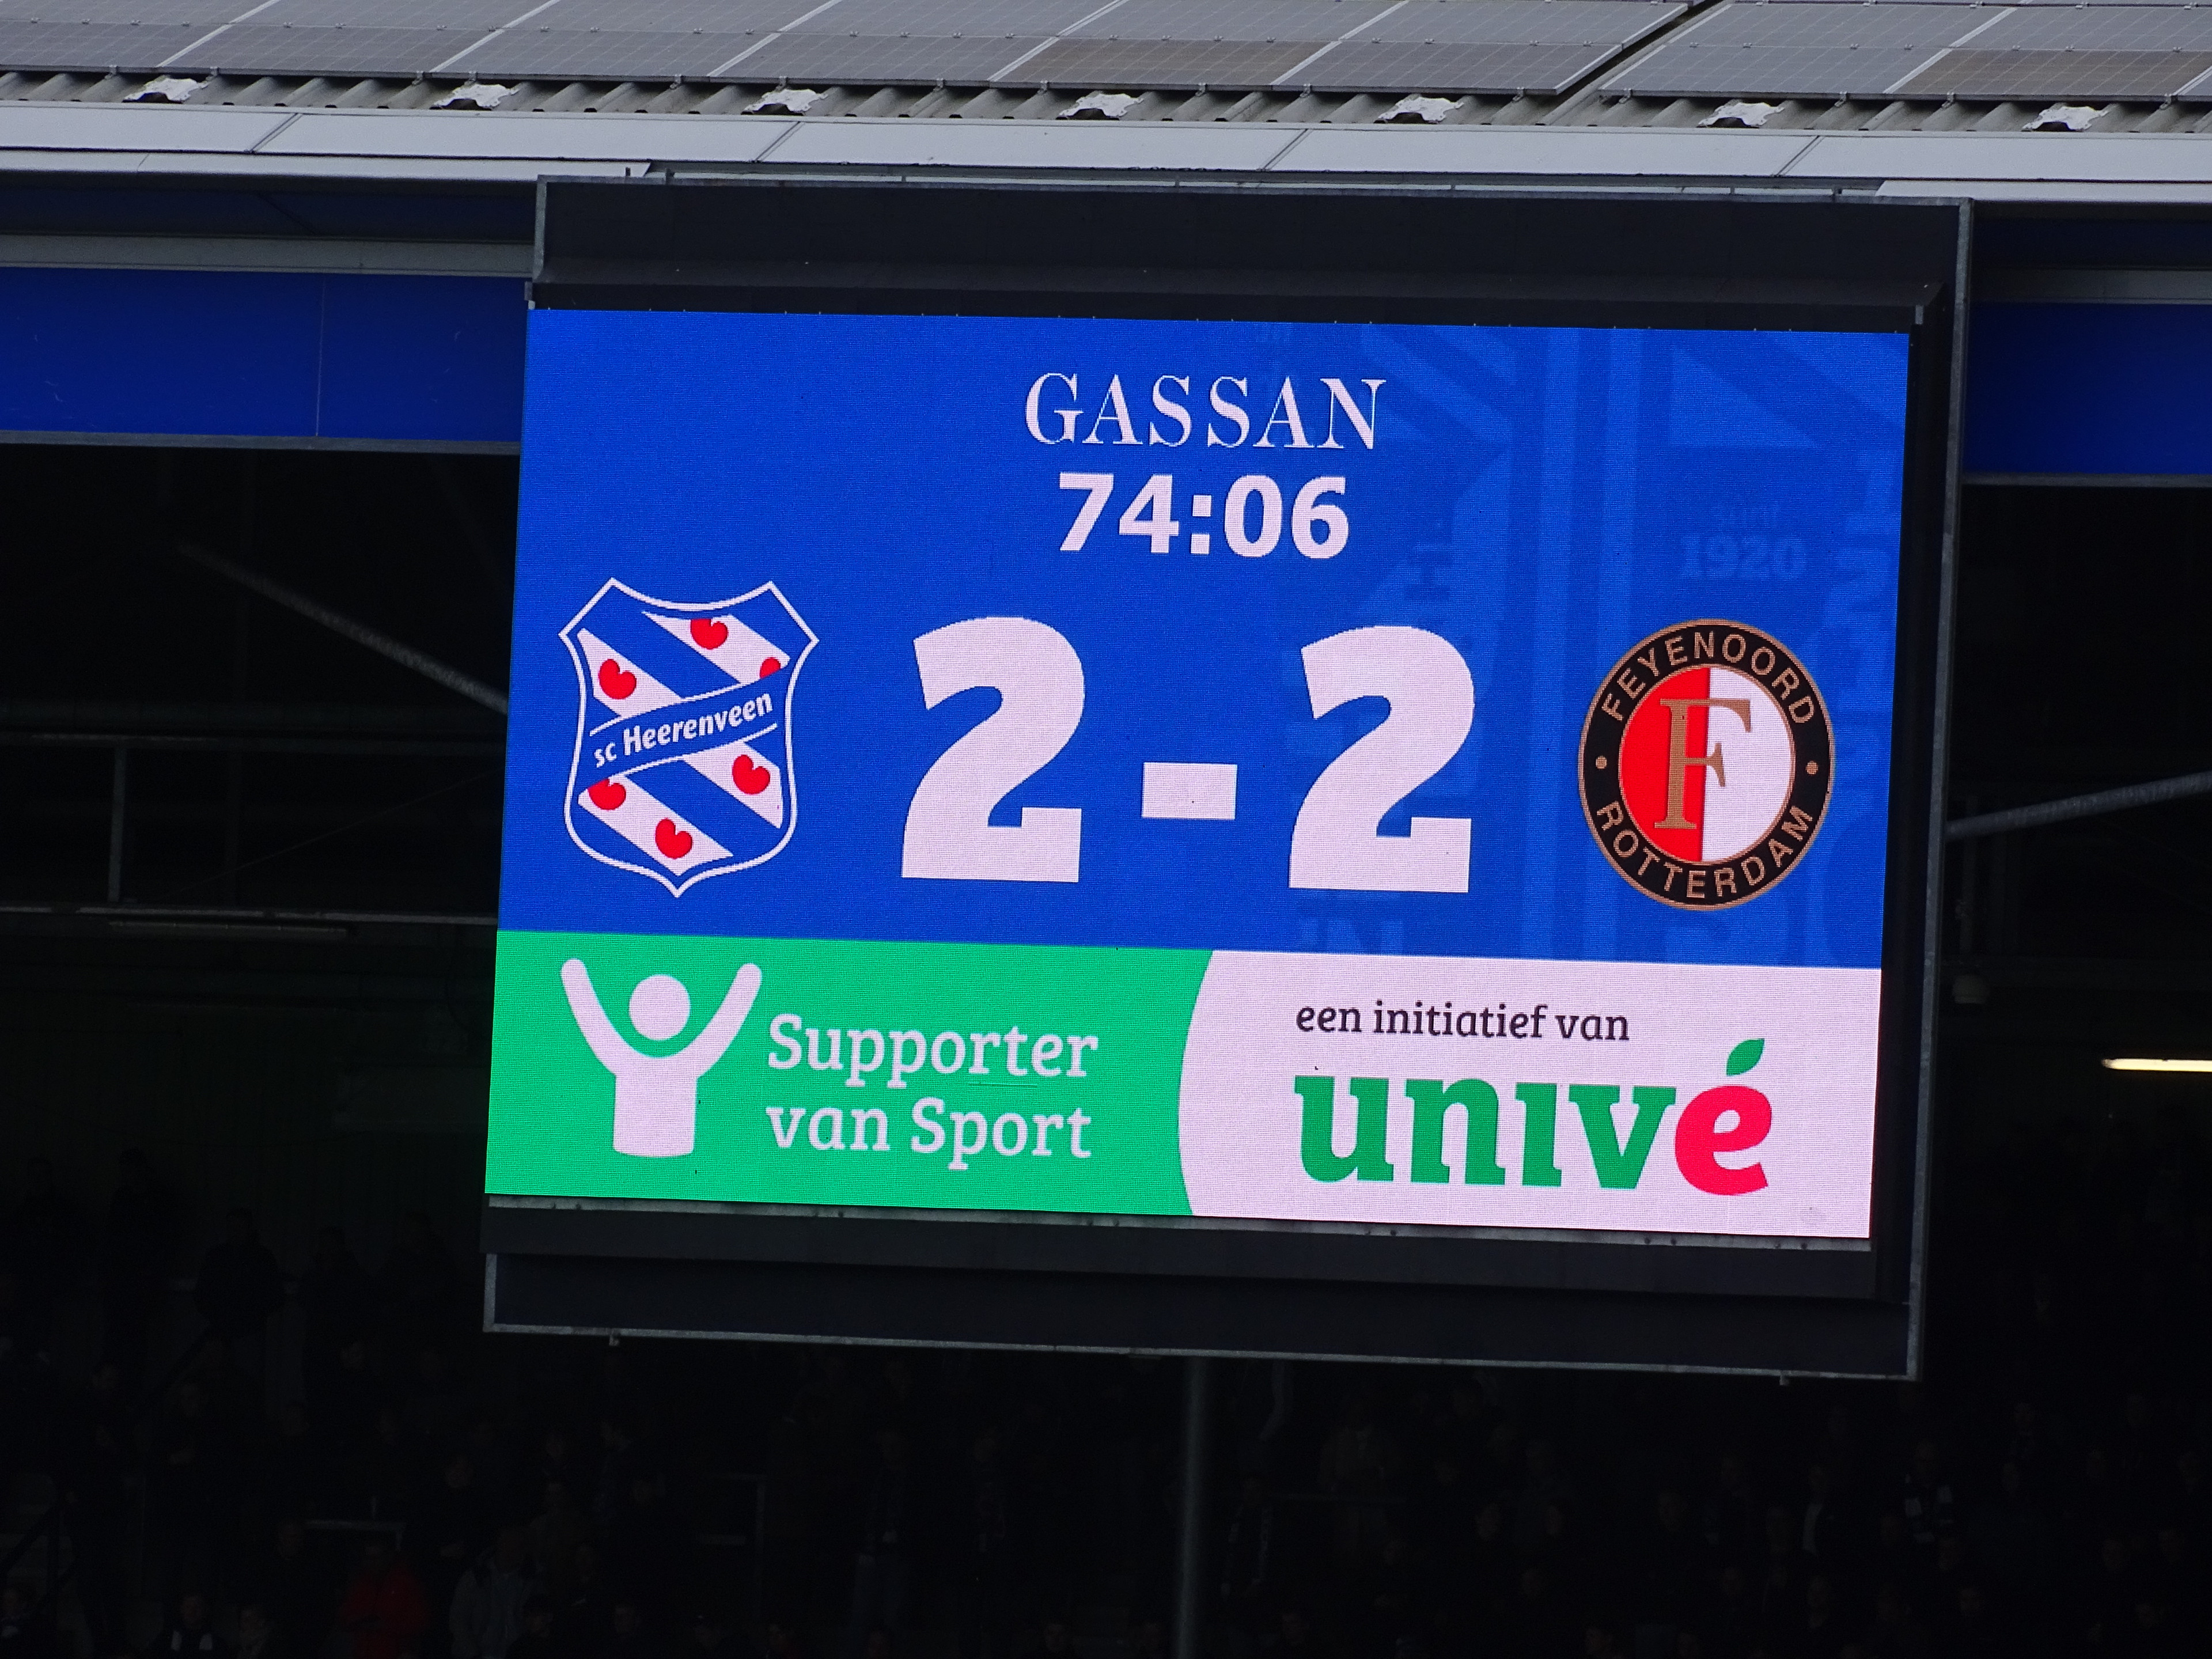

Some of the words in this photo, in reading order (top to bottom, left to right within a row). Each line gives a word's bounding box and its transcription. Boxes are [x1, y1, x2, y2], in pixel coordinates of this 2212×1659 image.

[1025, 372, 1387, 449] GASSAN
[1059, 472, 1349, 559] 74:06
[1679, 533, 1807, 581] 1920
[1601, 631, 1815, 724] FEYENOORD
[593, 742, 616, 768] sc
[623, 693, 773, 755] Heerenveen
[902, 616, 1084, 882] 2
[1289, 625, 1475, 893] 2
[1654, 698, 1751, 830] F
[1596, 801, 1812, 899] ROTTERDAM
[768, 1013, 1098, 1089] Supporter
[1296, 1002, 1361, 1033] een
[1374, 999, 1549, 1039] initiatief
[1555, 1010, 1630, 1041] van
[766, 1107, 891, 1152] van
[911, 1097, 1092, 1171] Sport
[1294, 1038, 1772, 1196] univé
